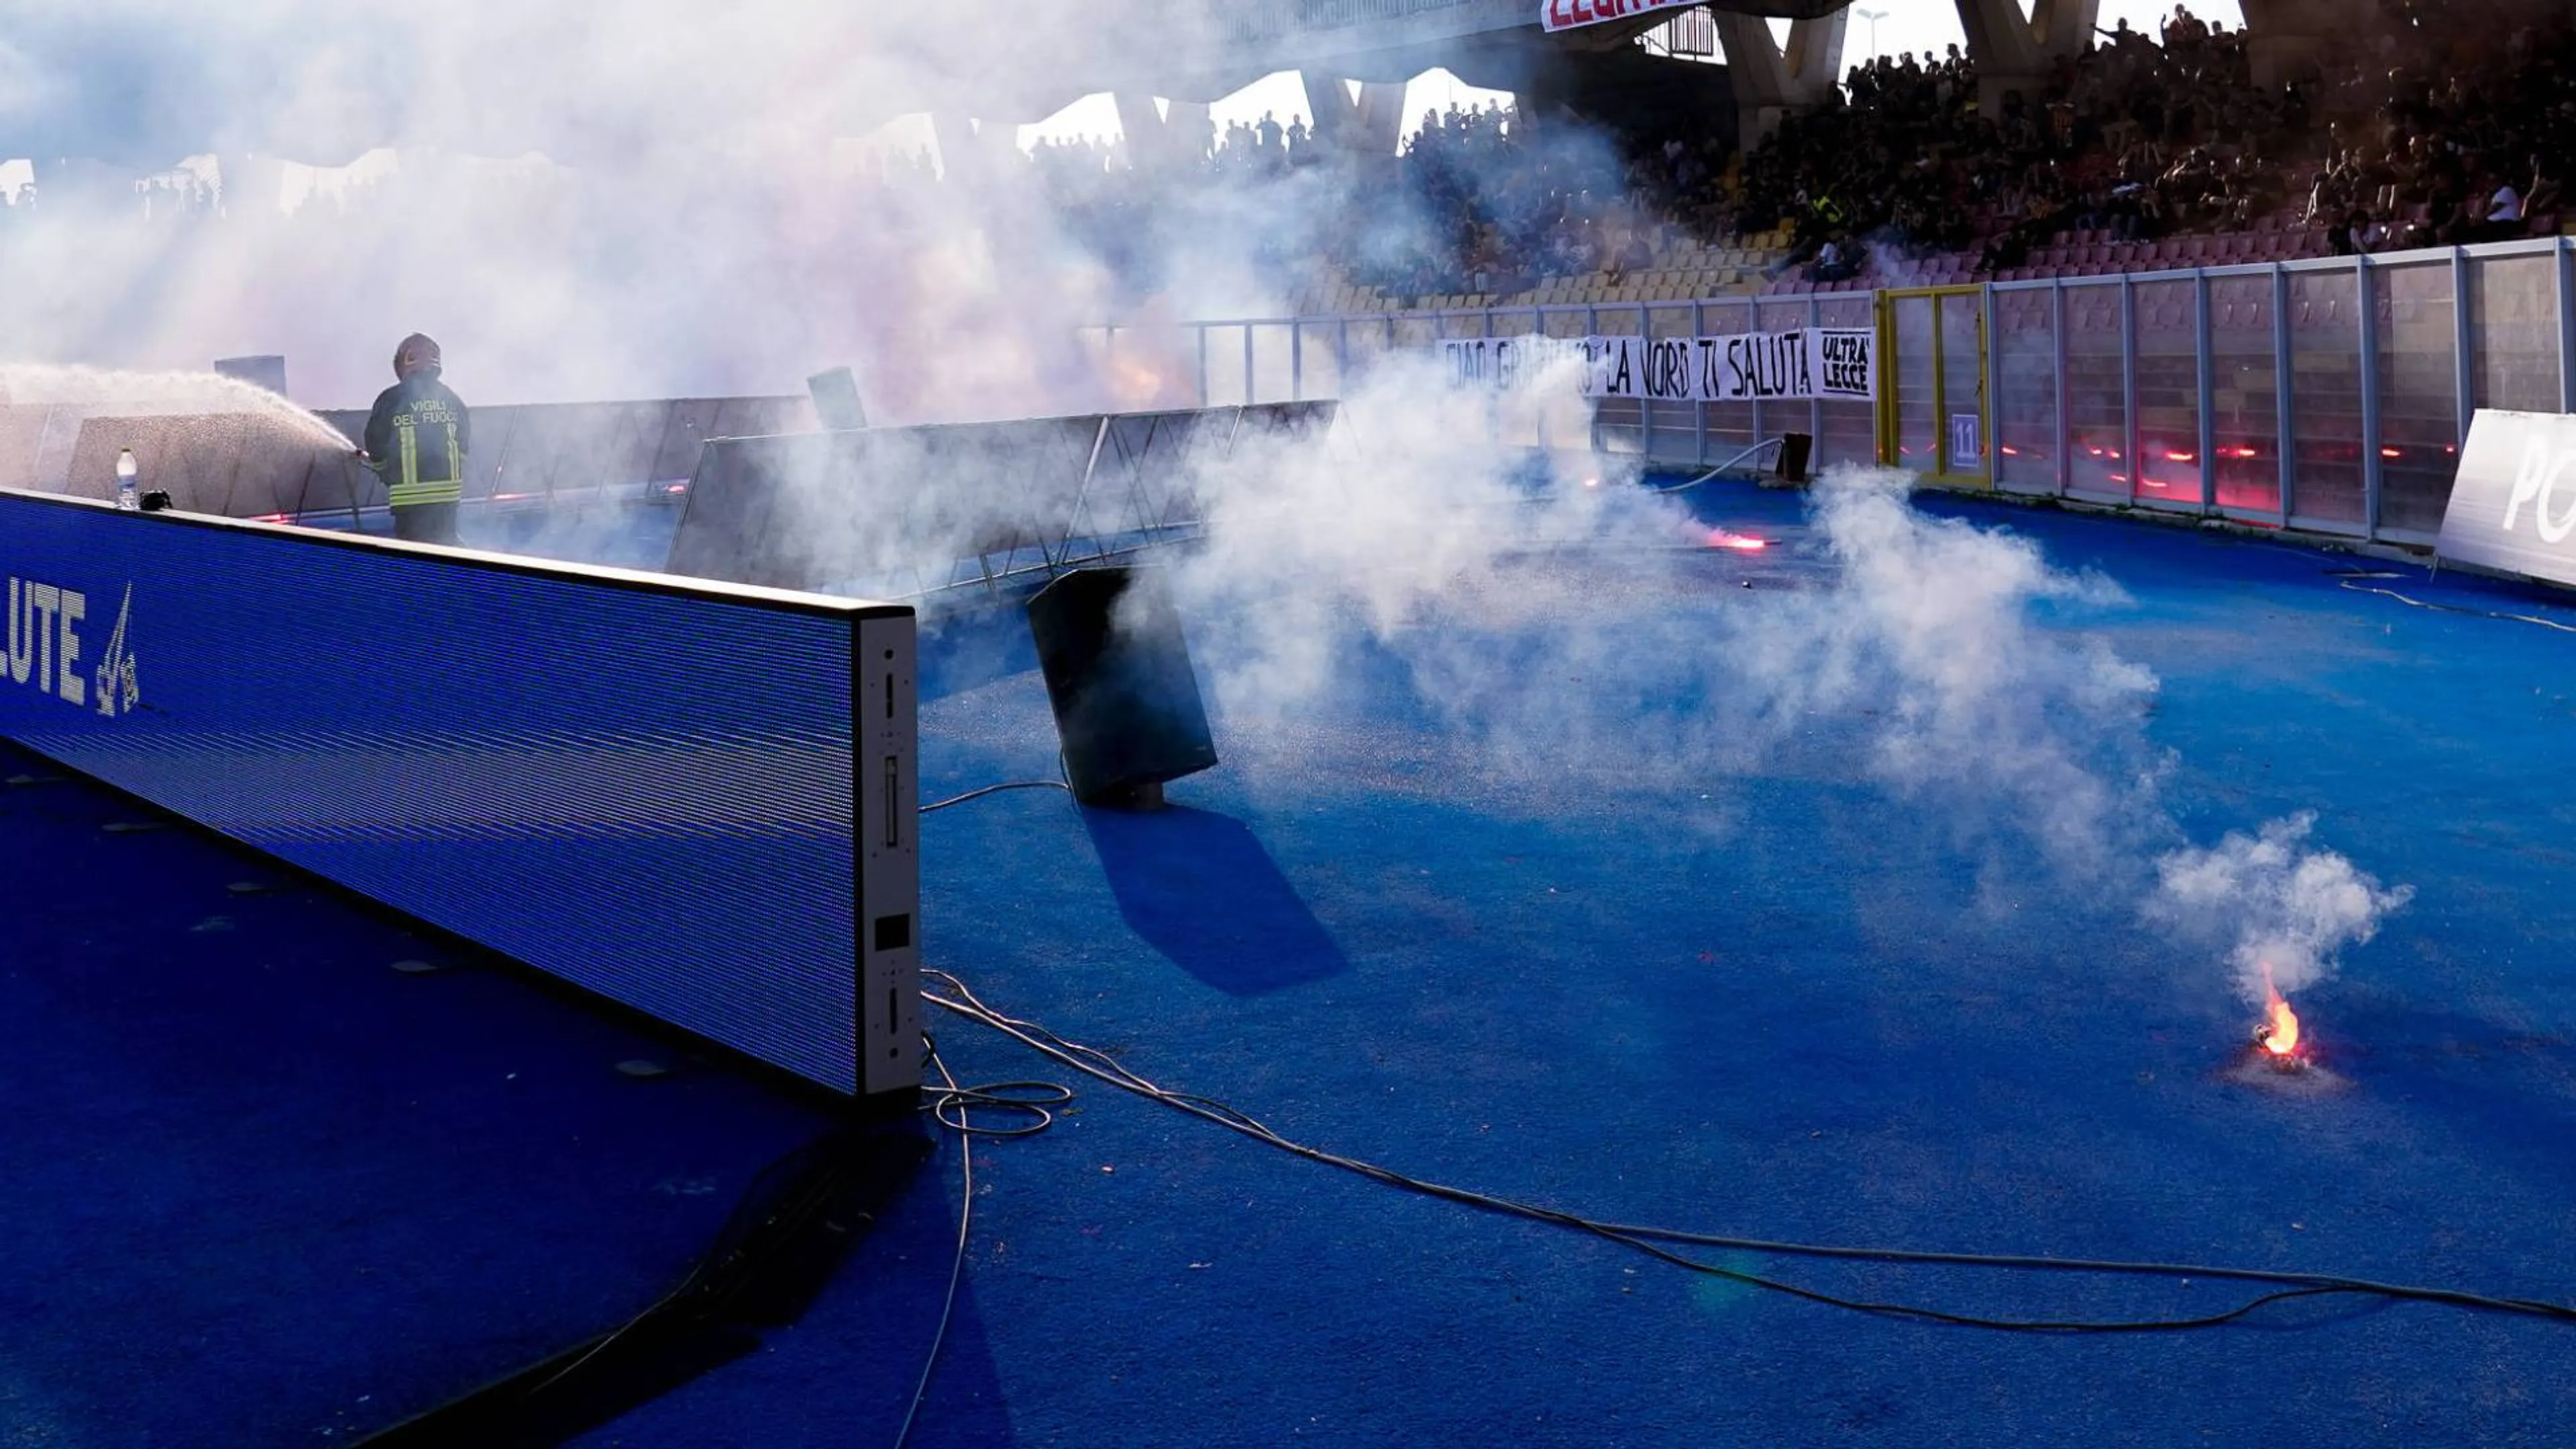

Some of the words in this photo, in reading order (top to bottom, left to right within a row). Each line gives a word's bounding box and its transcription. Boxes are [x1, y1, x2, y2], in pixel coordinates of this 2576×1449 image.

[1606, 339, 1631, 393] LA
[1699, 339, 1719, 398] TI
[1727, 332, 1812, 397] SALUTA
[1823, 363, 1868, 390] LECCE
[393, 414, 418, 426] DEL
[1956, 423, 1976, 458] 11
